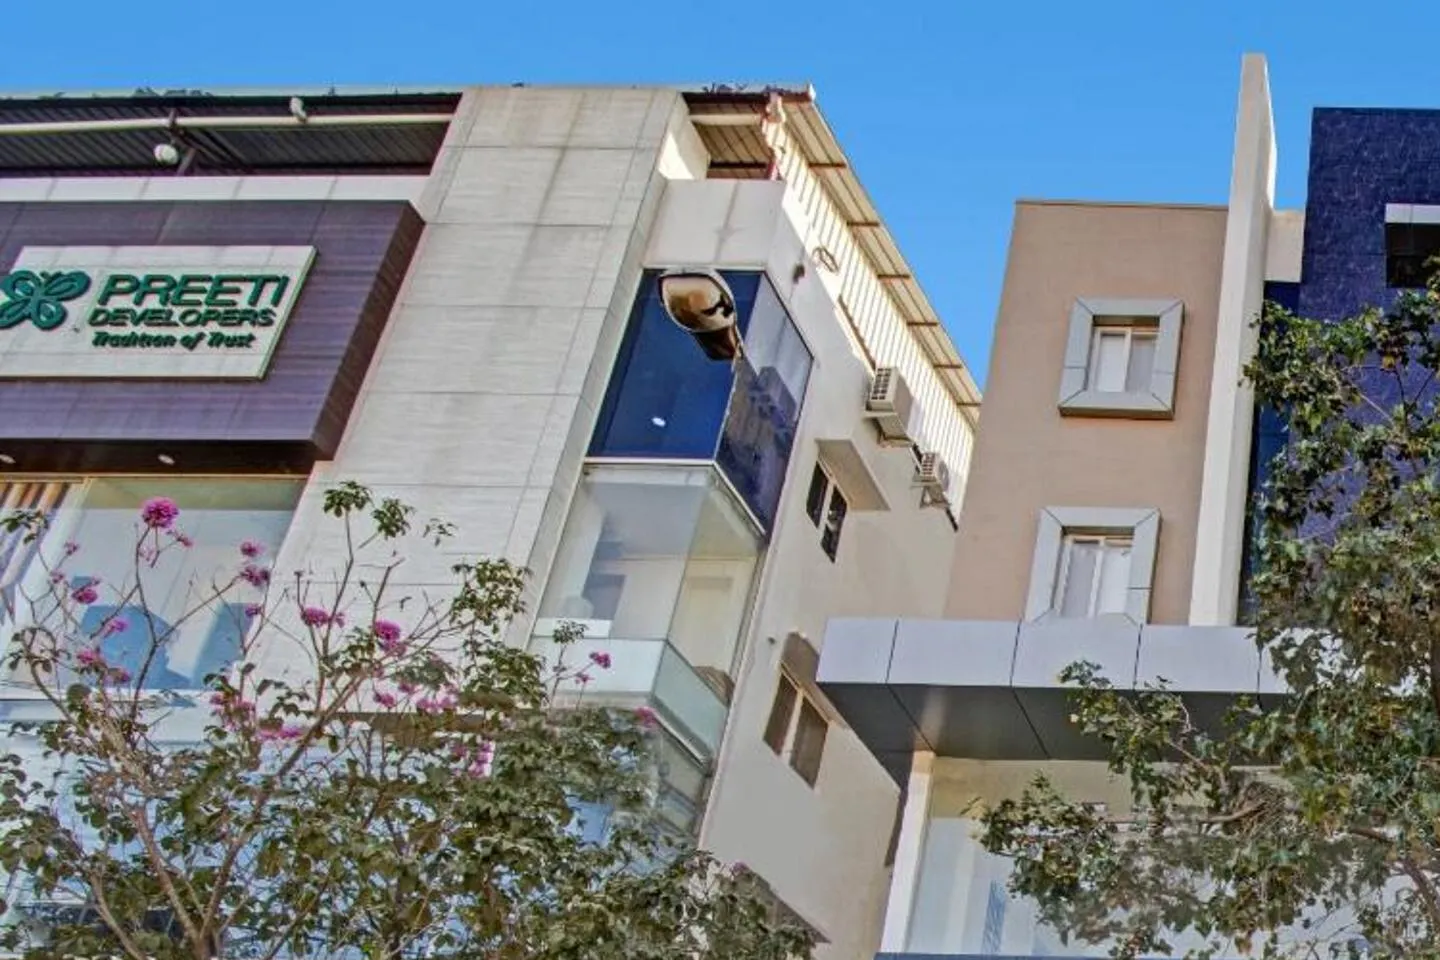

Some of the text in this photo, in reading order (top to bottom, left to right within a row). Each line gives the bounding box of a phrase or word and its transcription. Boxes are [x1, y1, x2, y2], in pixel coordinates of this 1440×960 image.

[97, 273, 289, 306] PREETI
[88, 308, 276, 328] DEVELOPERS
[91, 331, 256, 351] Tradition of Trust
